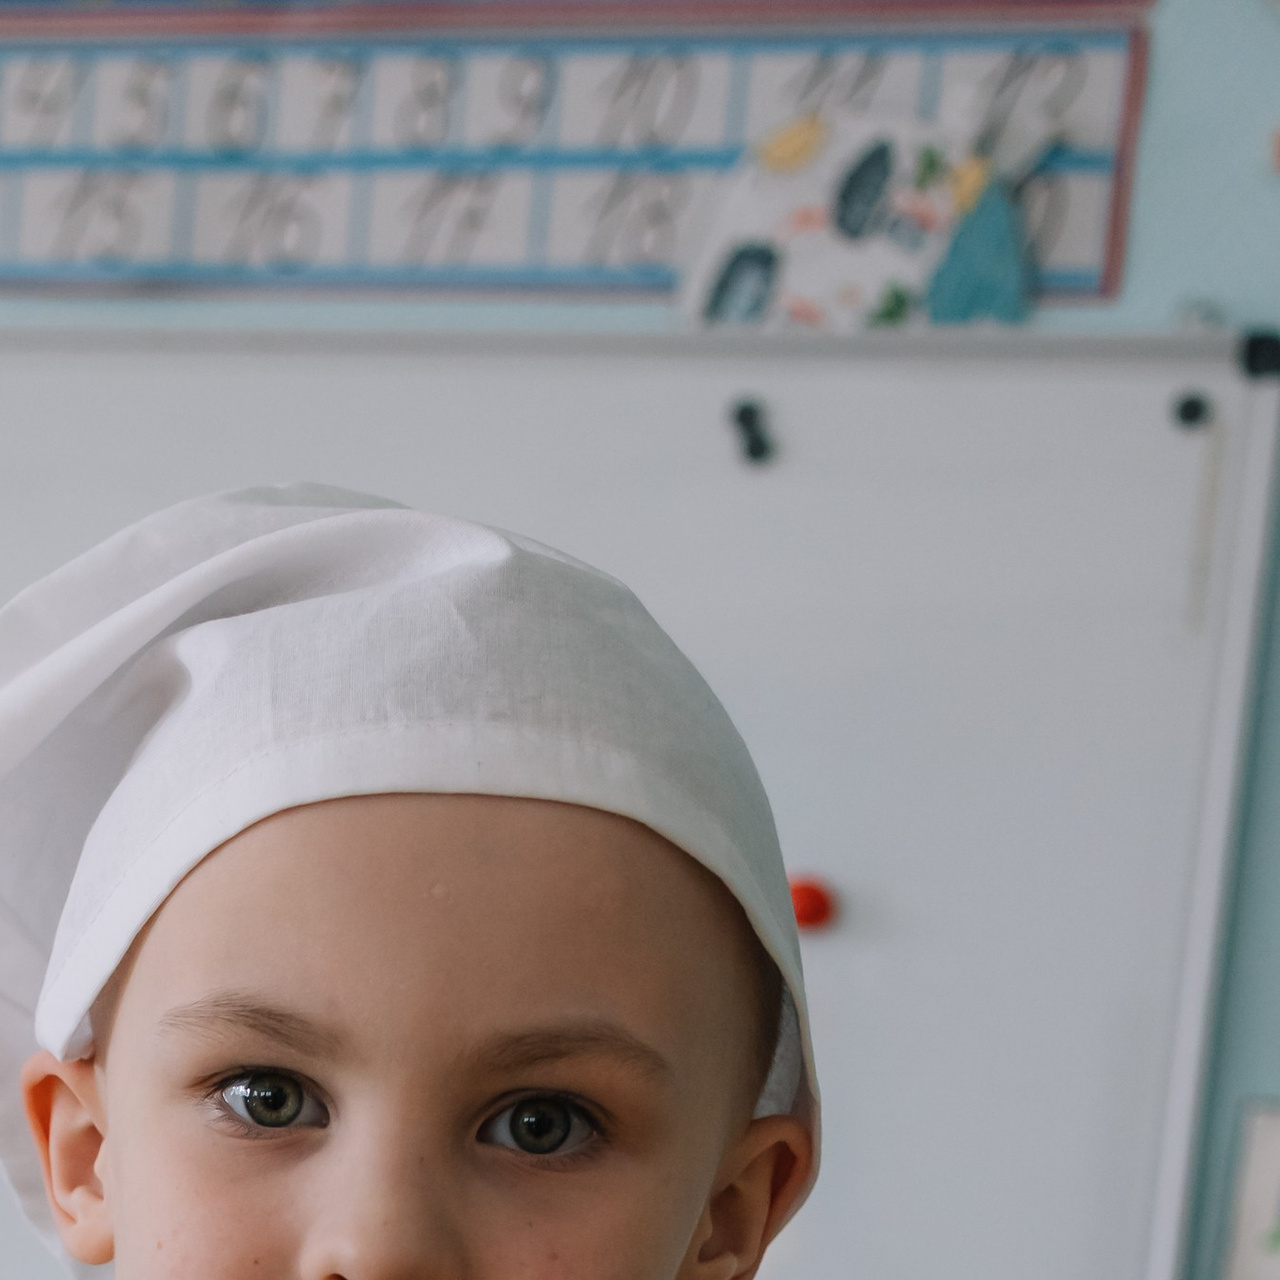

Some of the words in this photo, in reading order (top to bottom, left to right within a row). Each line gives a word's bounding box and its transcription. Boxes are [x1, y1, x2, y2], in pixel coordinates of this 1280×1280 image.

[16, 50, 95, 152] 4
[112, 50, 175, 156] 5
[208, 46, 270, 157] 6
[393, 44, 465, 156] 8
[498, 44, 562, 156] 9
[596, 42, 699, 152] 10
